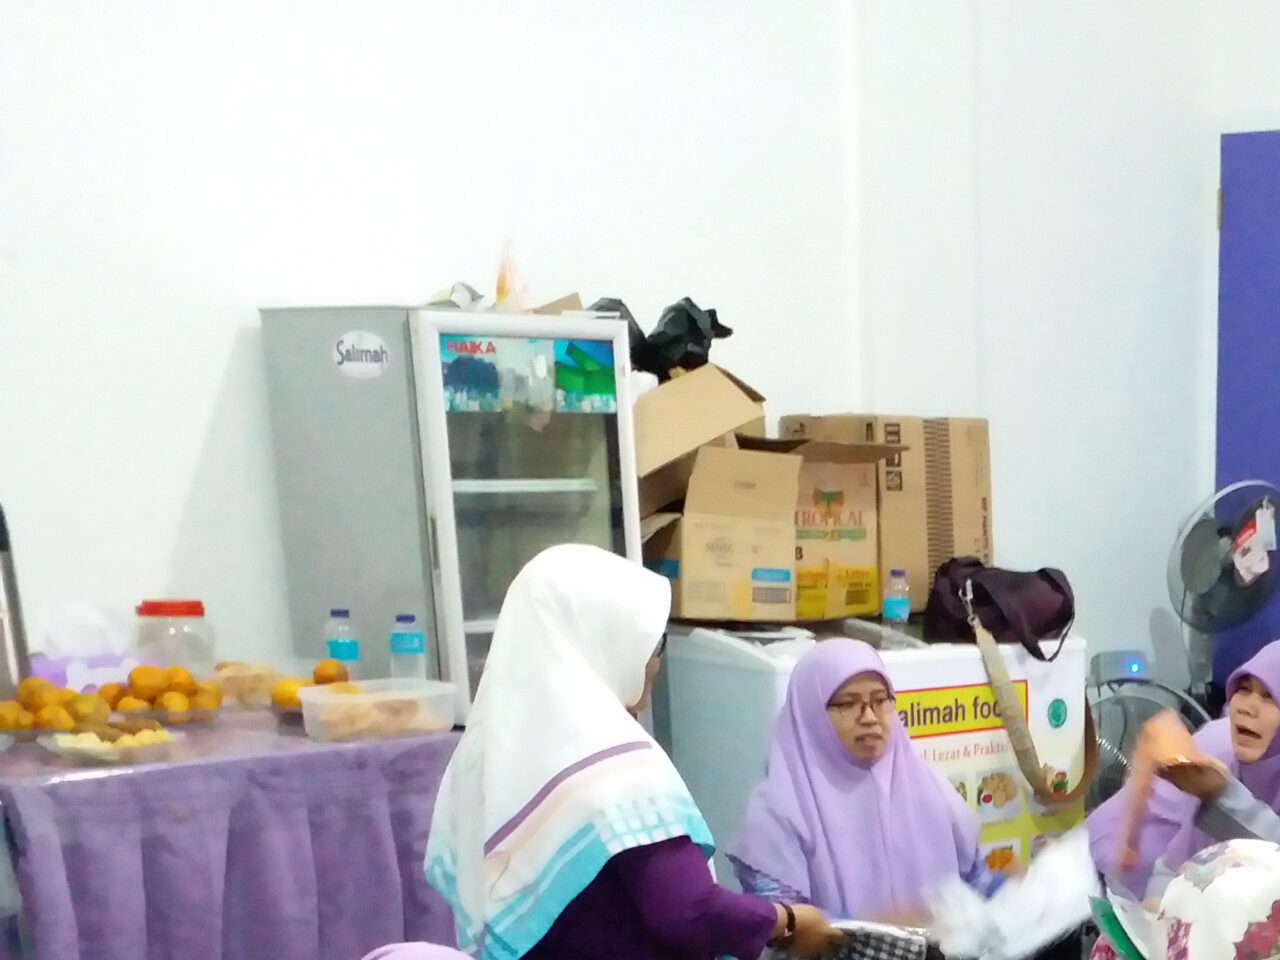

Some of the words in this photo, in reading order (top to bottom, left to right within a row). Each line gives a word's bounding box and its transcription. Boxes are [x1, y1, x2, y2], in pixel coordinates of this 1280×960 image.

[336, 340, 388, 365] Salimah
[898, 698, 966, 728] alimah
[972, 695, 1003, 720] foo
